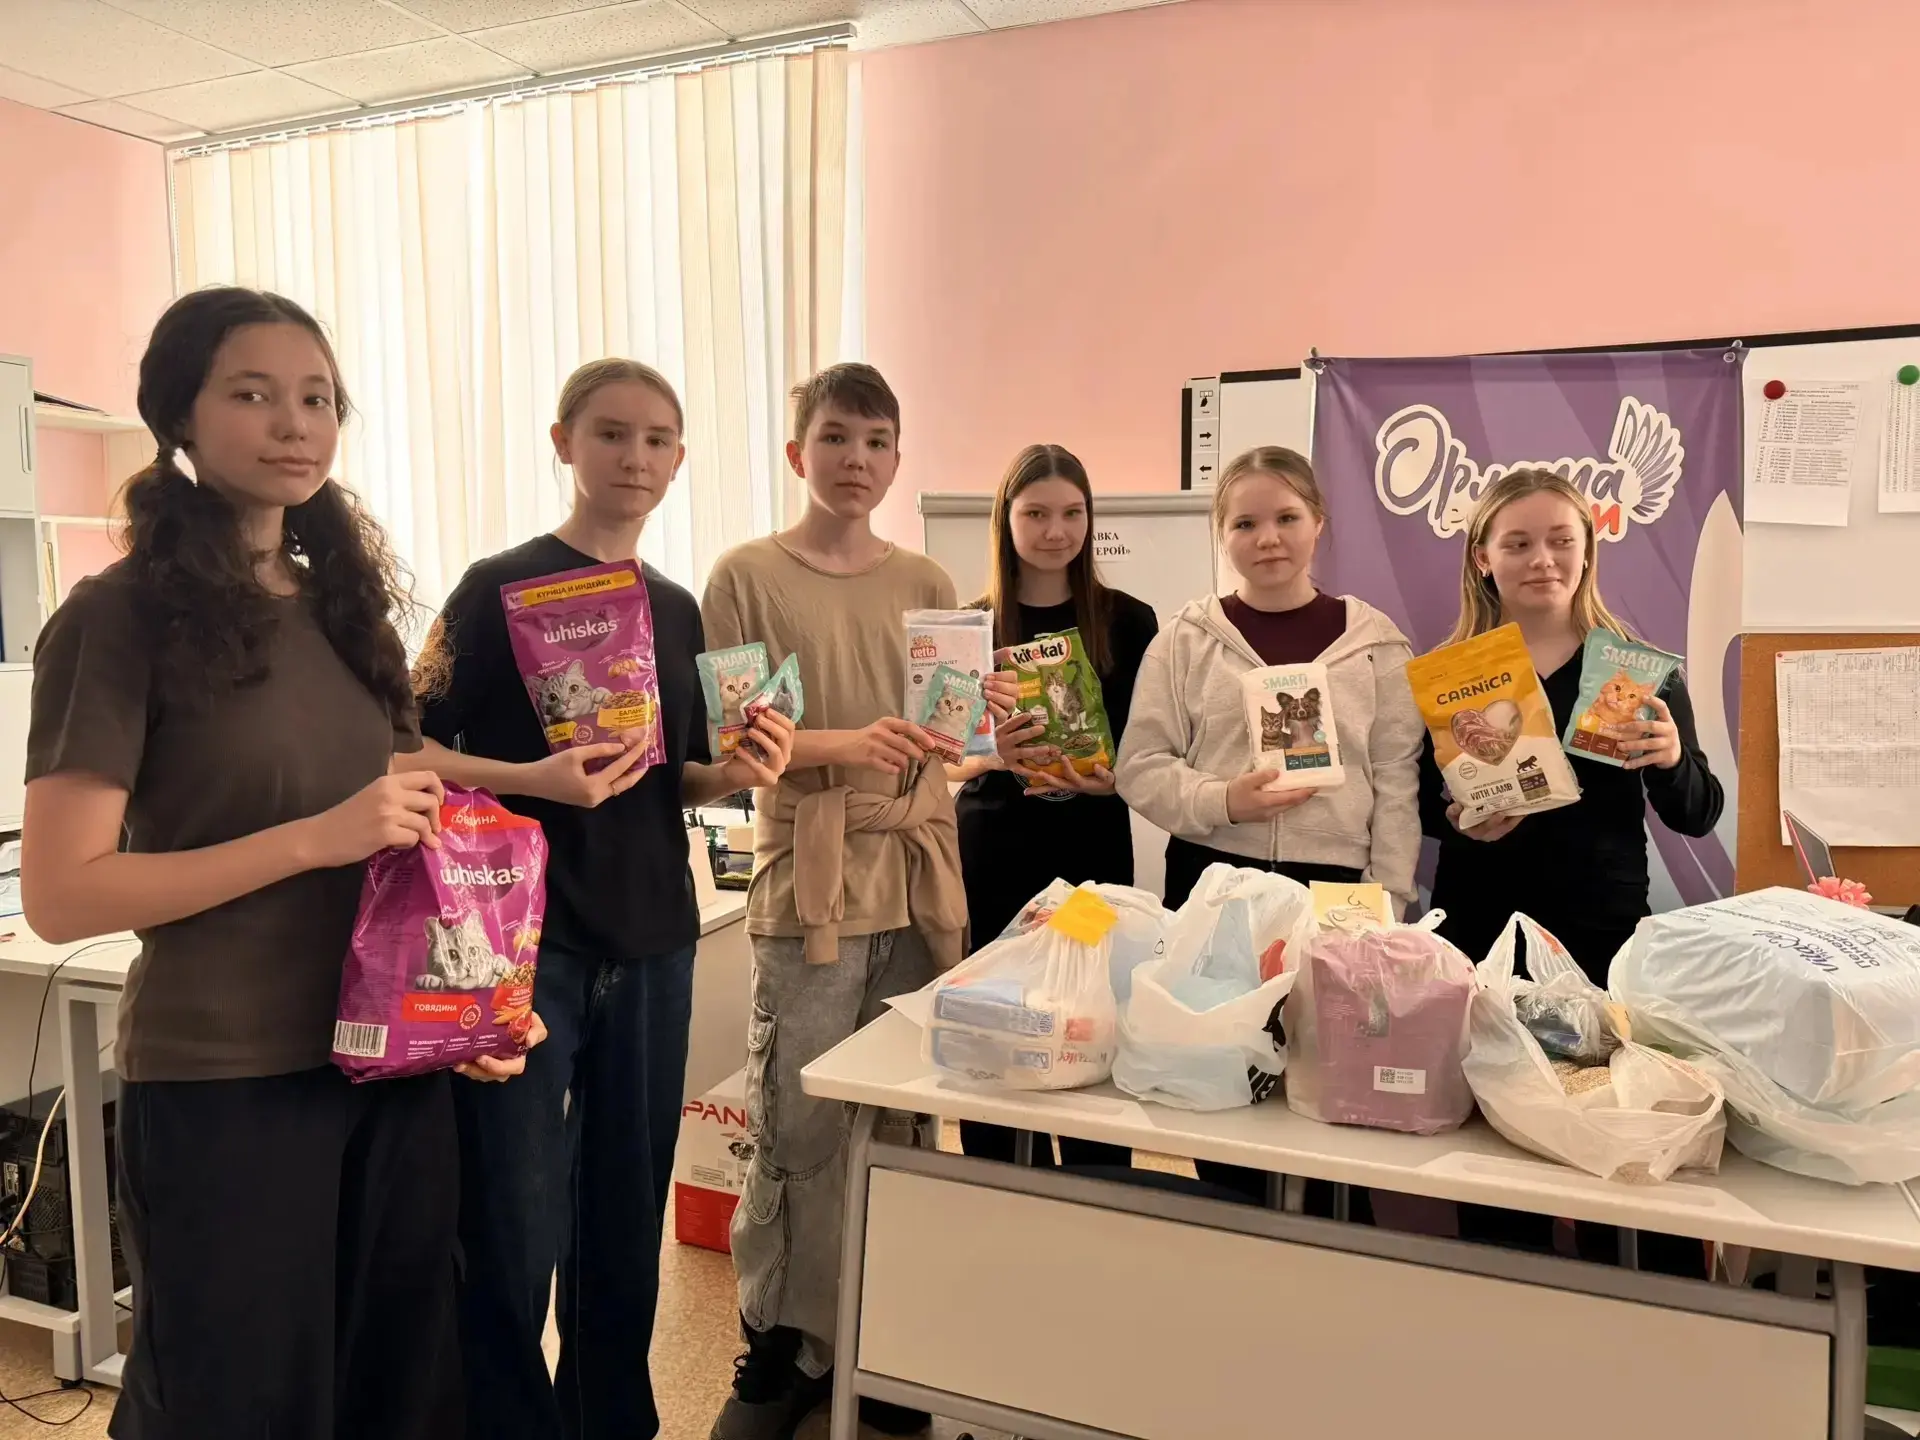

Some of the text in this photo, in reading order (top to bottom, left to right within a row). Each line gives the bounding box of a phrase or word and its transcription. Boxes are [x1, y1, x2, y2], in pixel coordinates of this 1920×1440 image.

[1380, 408, 1624, 521] Орлта
[1094, 544, 1131, 556] ЕРОЙ»
[536, 586, 567, 599] КУРИЦА
[574, 579, 612, 592] ИНДЕЙКА
[543, 619, 618, 644] whiskas
[911, 646, 936, 658] vetta
[1013, 642, 1065, 664] kitekat
[1600, 645, 1665, 673] SMARTI
[1262, 673, 1308, 690] SMARTI
[1470, 788, 1491, 801] WITH
[1491, 783, 1513, 796] LAMB
[439, 862, 526, 887] whiskas
[414, 1003, 458, 1012] ГОВЯДИНА
[682, 1100, 749, 1132] PAN
